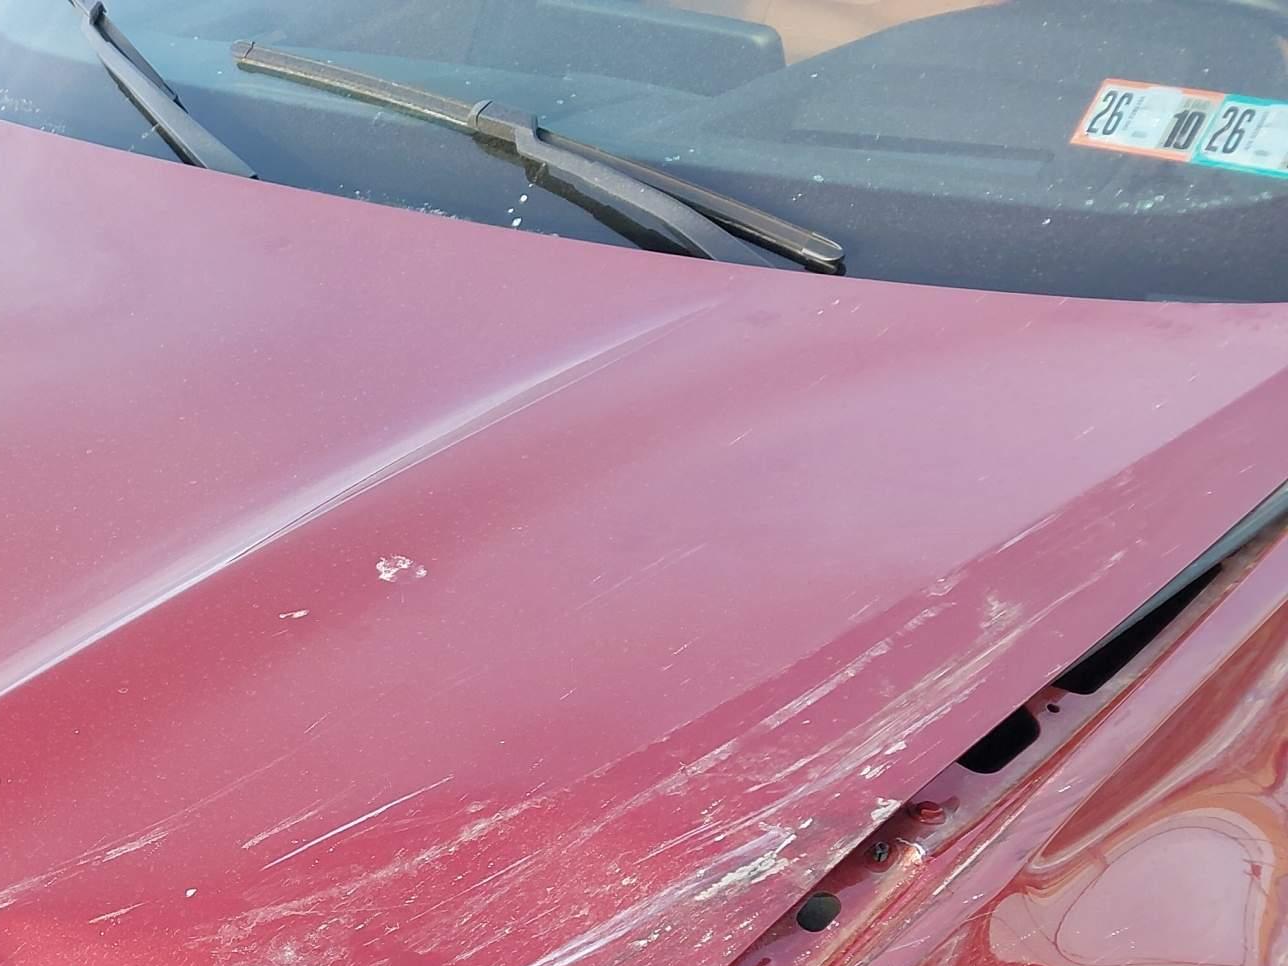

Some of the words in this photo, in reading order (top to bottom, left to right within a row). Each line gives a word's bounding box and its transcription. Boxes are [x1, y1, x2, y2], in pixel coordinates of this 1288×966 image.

[1086, 90, 1134, 136] 26
[1163, 109, 1207, 150] 10
[1204, 106, 1256, 154] 26
